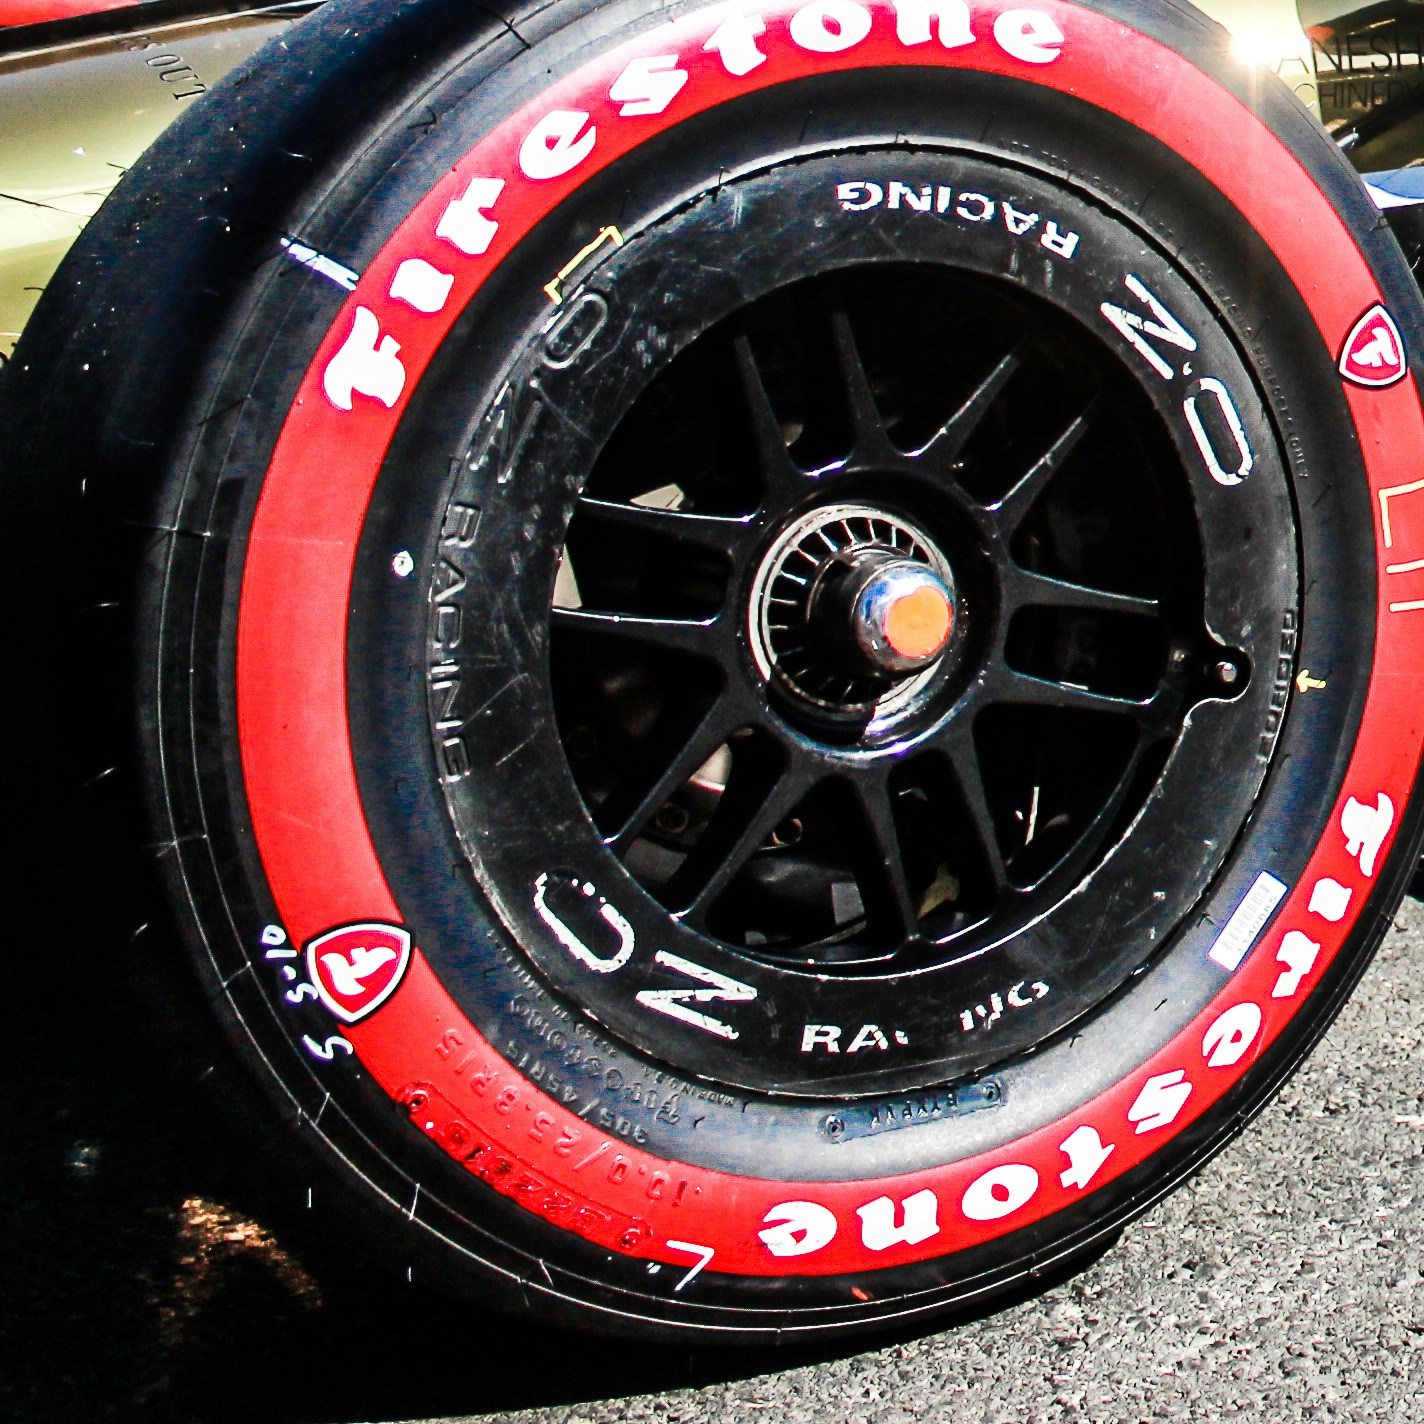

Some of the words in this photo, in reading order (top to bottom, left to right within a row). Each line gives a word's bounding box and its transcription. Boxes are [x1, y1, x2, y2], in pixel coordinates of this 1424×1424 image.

[1275, 33, 1424, 75] ANESH
[835, 179, 1081, 260] RACING
[428, 500, 485, 785] RACING
[756, 792, 1395, 1259] Firestone
